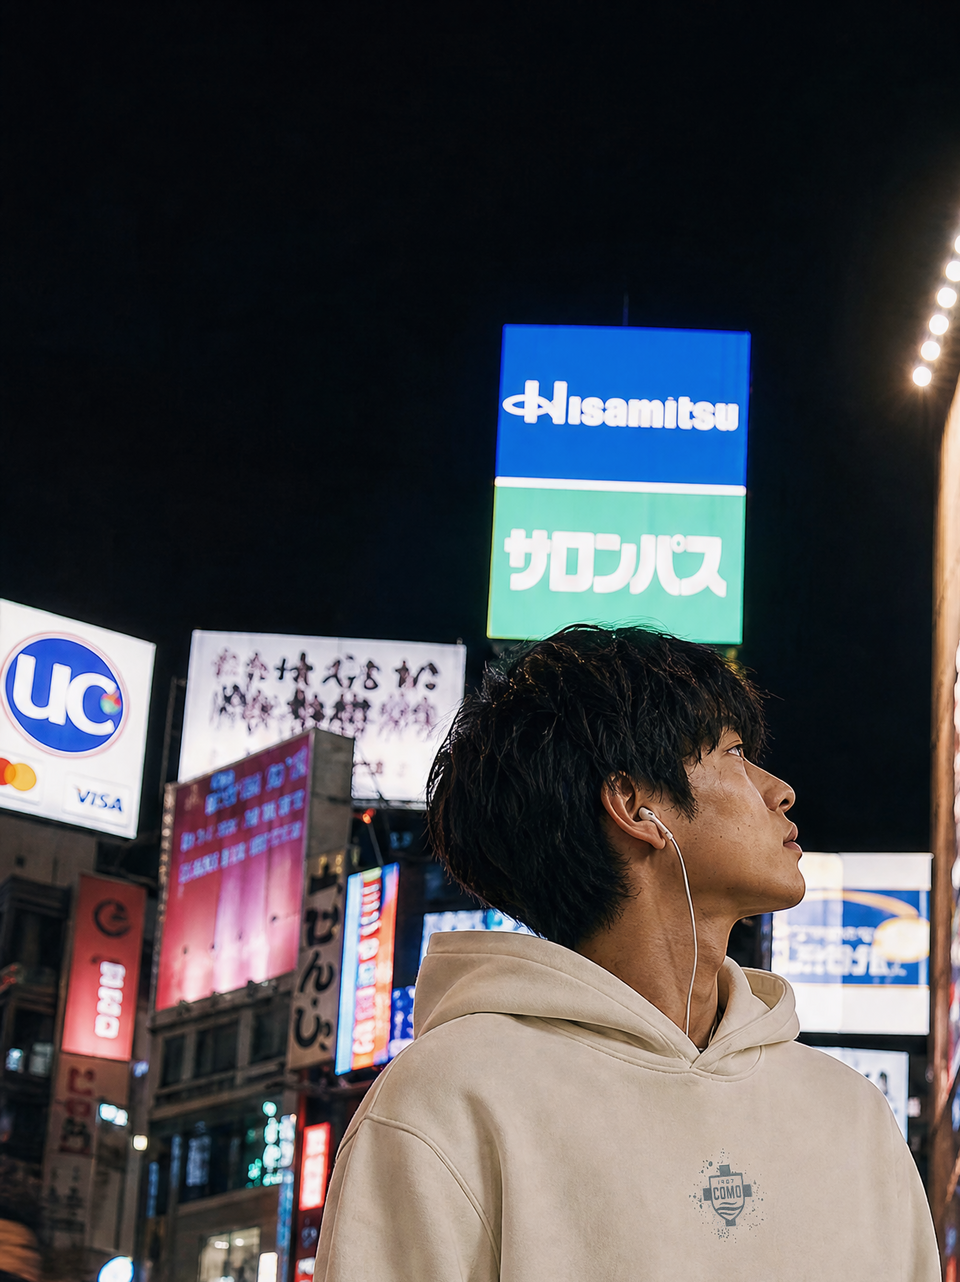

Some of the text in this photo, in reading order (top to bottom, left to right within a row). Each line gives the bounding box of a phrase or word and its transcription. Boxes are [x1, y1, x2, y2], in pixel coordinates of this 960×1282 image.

[502, 379, 739, 432] Hisamitsu
[503, 528, 728, 598] サロンパス
[74, 788, 123, 812] VISA
[713, 1185, 742, 1200] COMO
